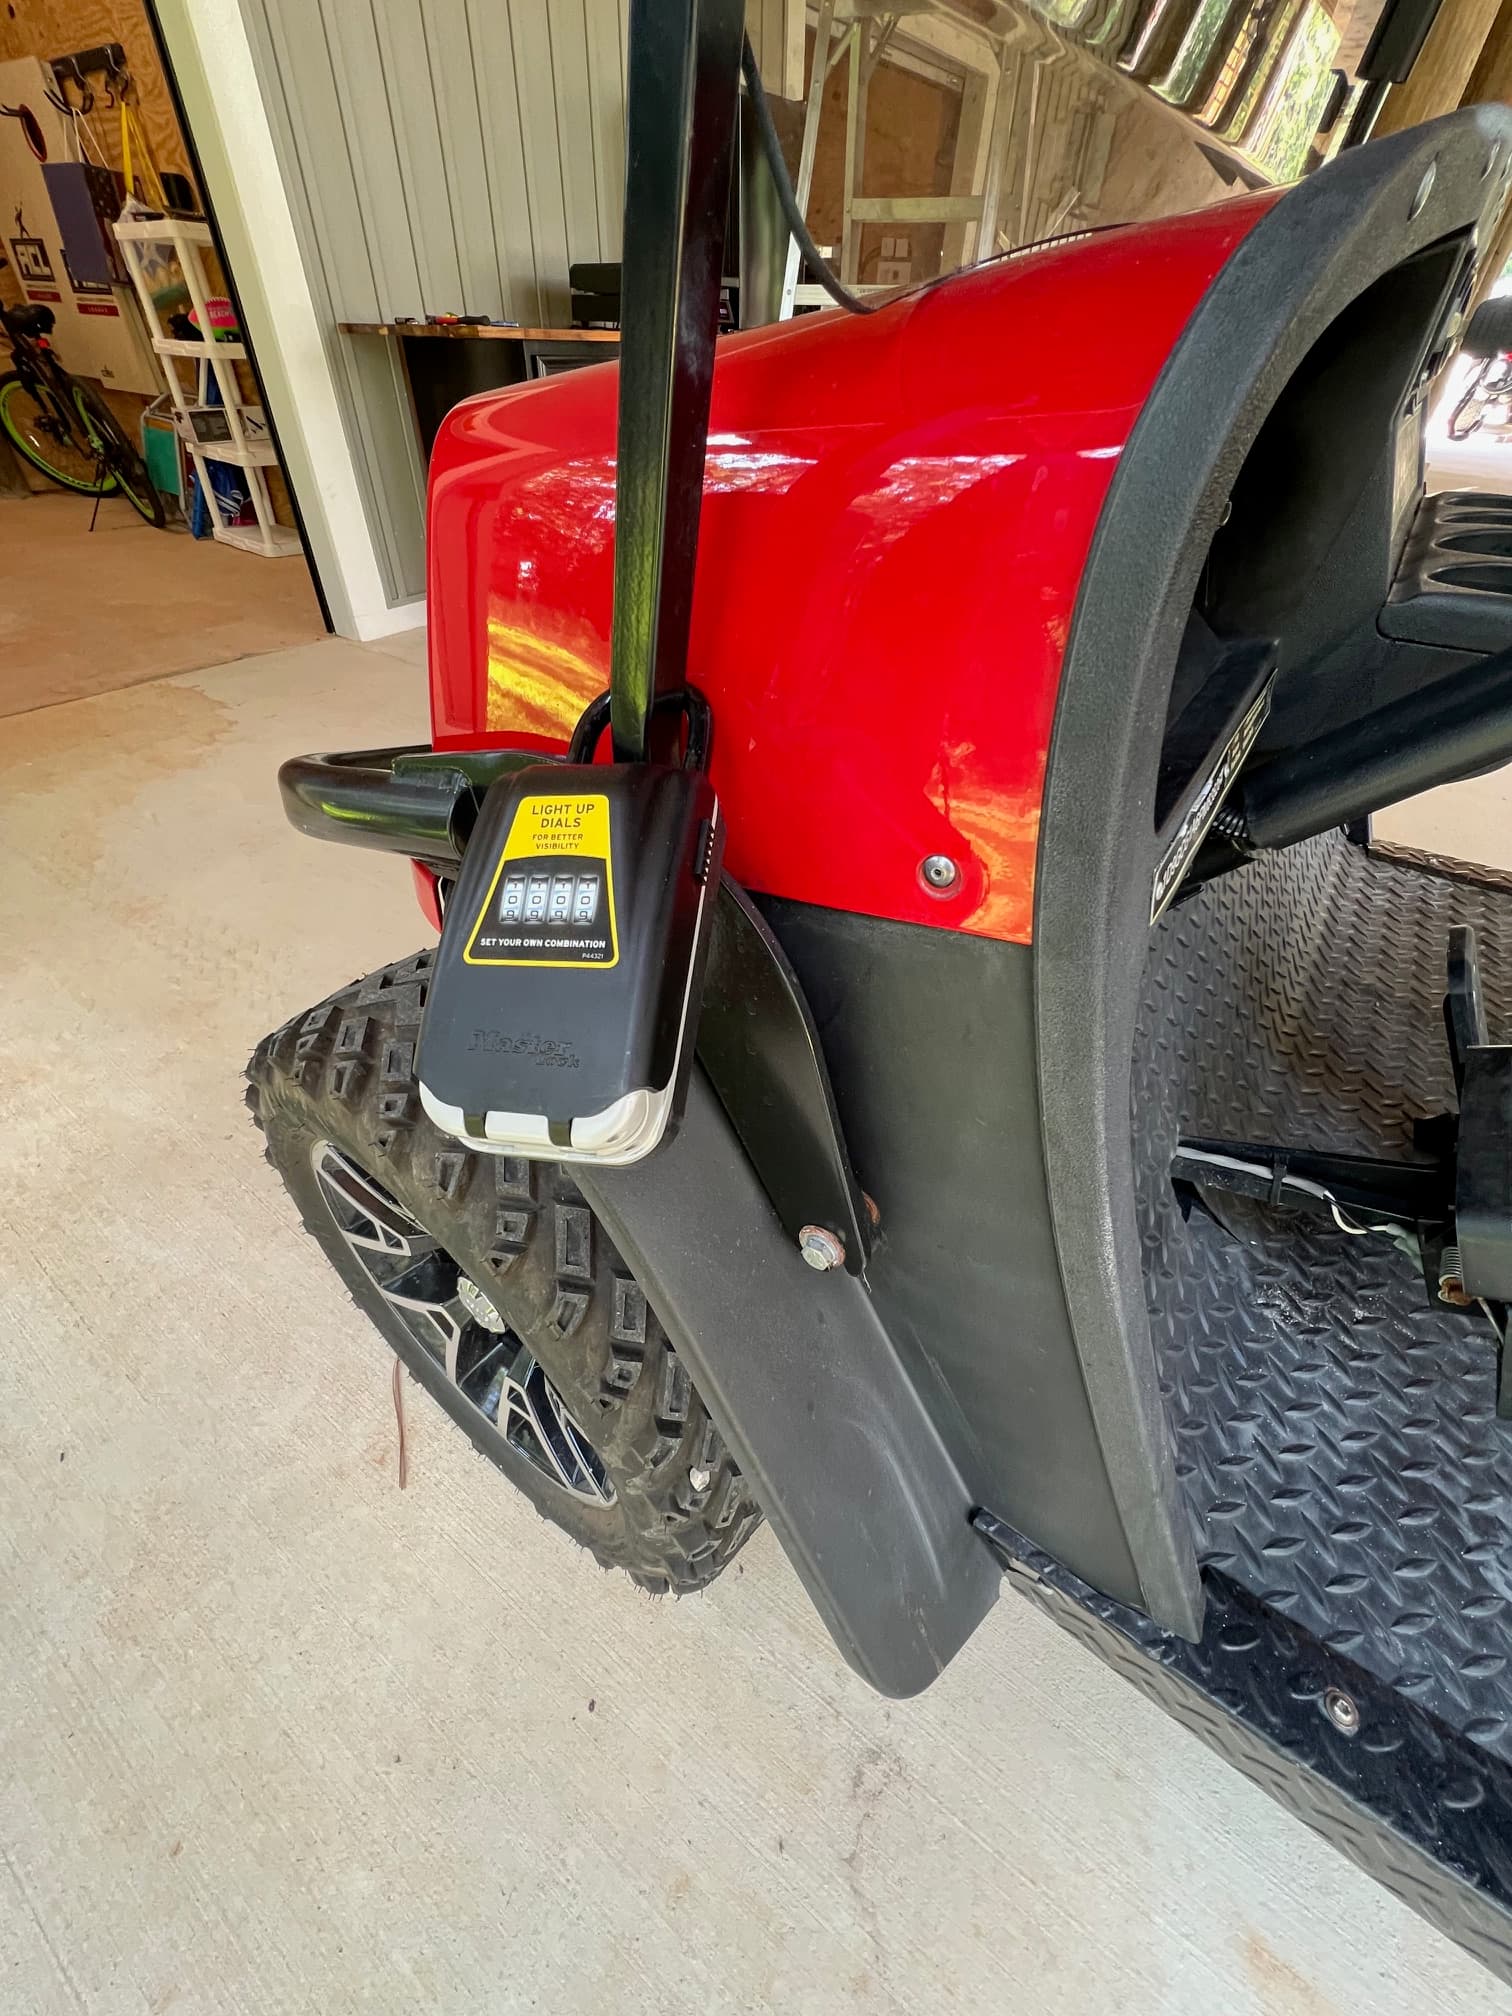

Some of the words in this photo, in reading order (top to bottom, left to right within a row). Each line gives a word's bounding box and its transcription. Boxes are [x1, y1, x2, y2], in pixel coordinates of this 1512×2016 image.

[15, 244, 52, 275] ACL
[532, 804, 571, 815] LIGHT
[576, 803, 595, 814] UP
[540, 818, 581, 828] DIALS
[532, 833, 549, 841] FOR
[551, 833, 584, 841] BETTER
[508, 896, 518, 905] 0
[532, 896, 542, 905] 0
[556, 896, 566, 905] 0
[581, 896, 591, 905] 0
[480, 938, 497, 946] SET
[499, 938, 522, 947] YOUR
[523, 939, 543, 947] OWN
[544, 939, 606, 949] COMBINATION
[467, 1030, 573, 1056] Master
